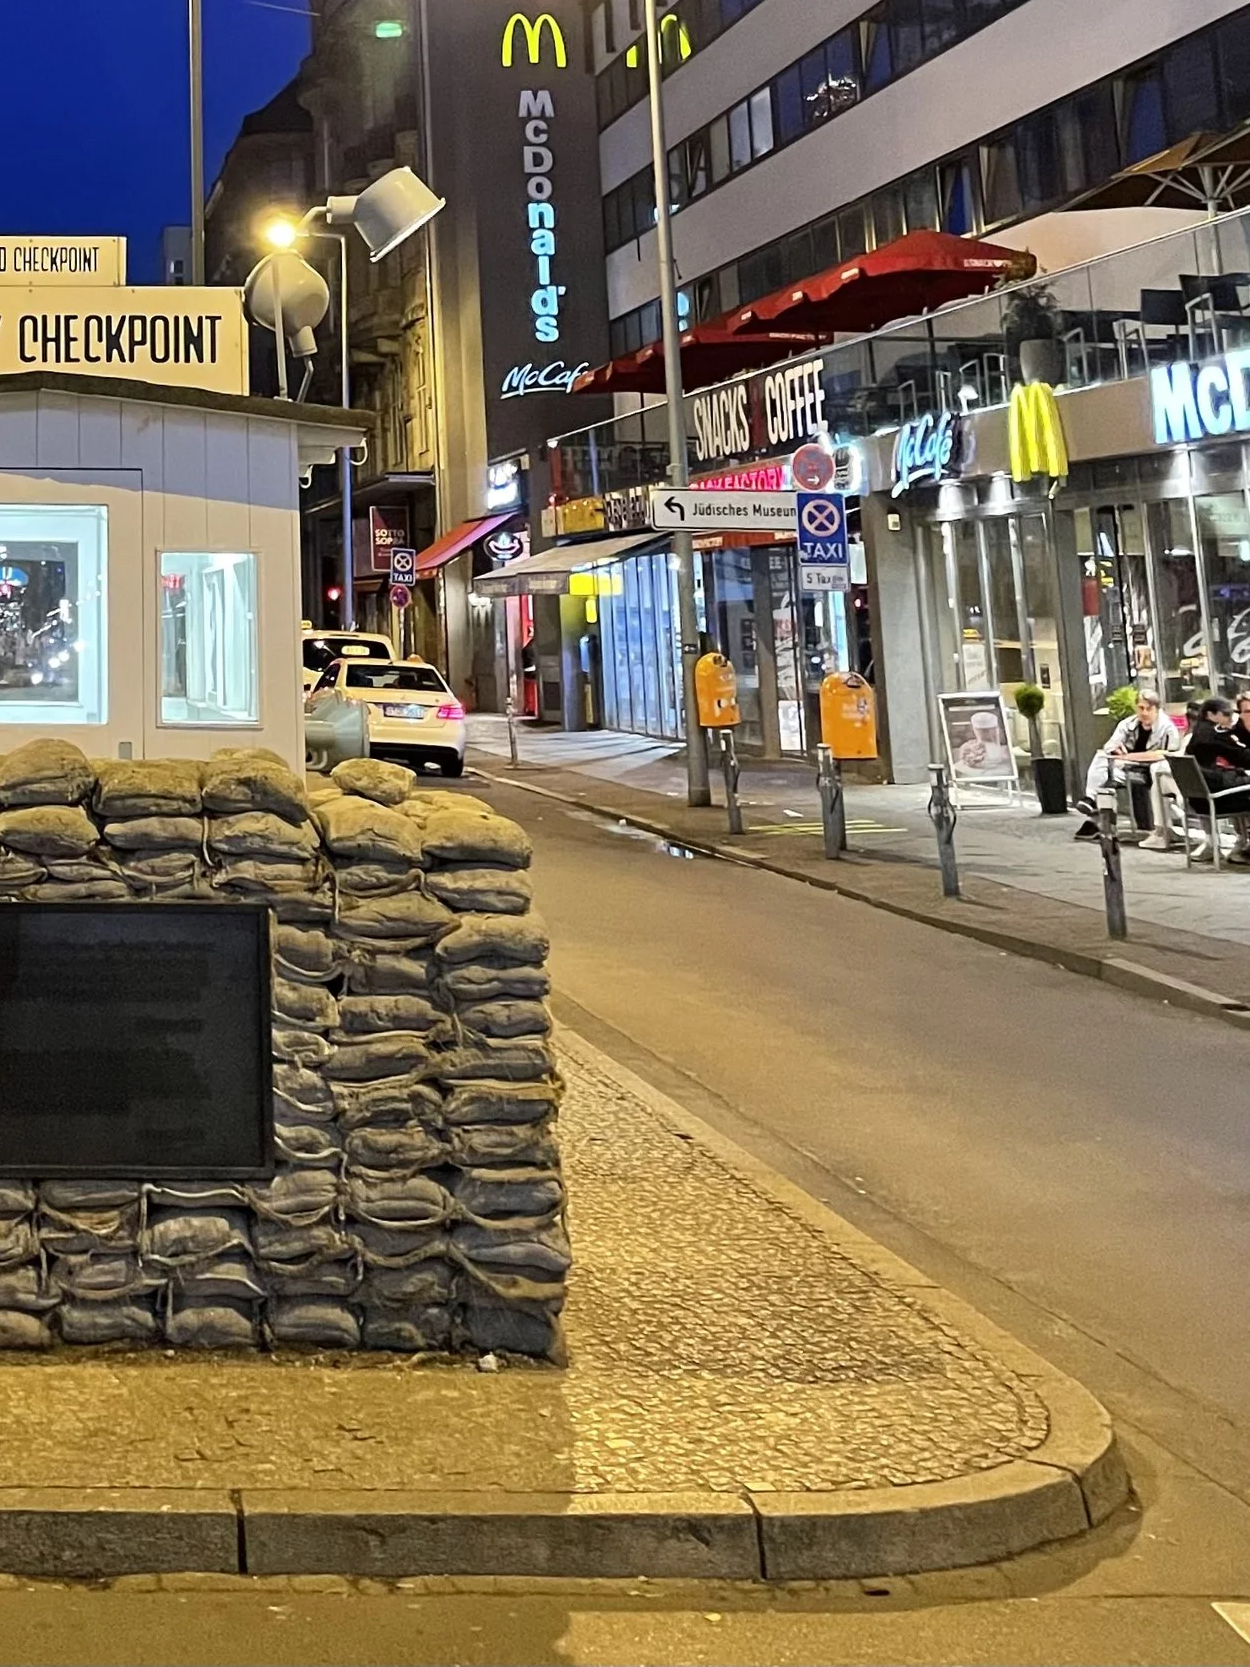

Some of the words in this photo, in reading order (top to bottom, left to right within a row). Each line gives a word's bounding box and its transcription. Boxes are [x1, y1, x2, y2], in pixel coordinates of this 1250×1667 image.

[13, 246, 100, 274] CHECKPOINT
[19, 314, 222, 364] CHECKPOINT
[501, 360, 589, 396] McCaf
[693, 384, 750, 461] SNACKS
[765, 358, 829, 445] COFFEE
[692, 501, 749, 517] Jüdisches
[374, 528, 405, 537] SOTTO
[803, 541, 844, 559] TAXI
[393, 572, 413, 582] TAXI
